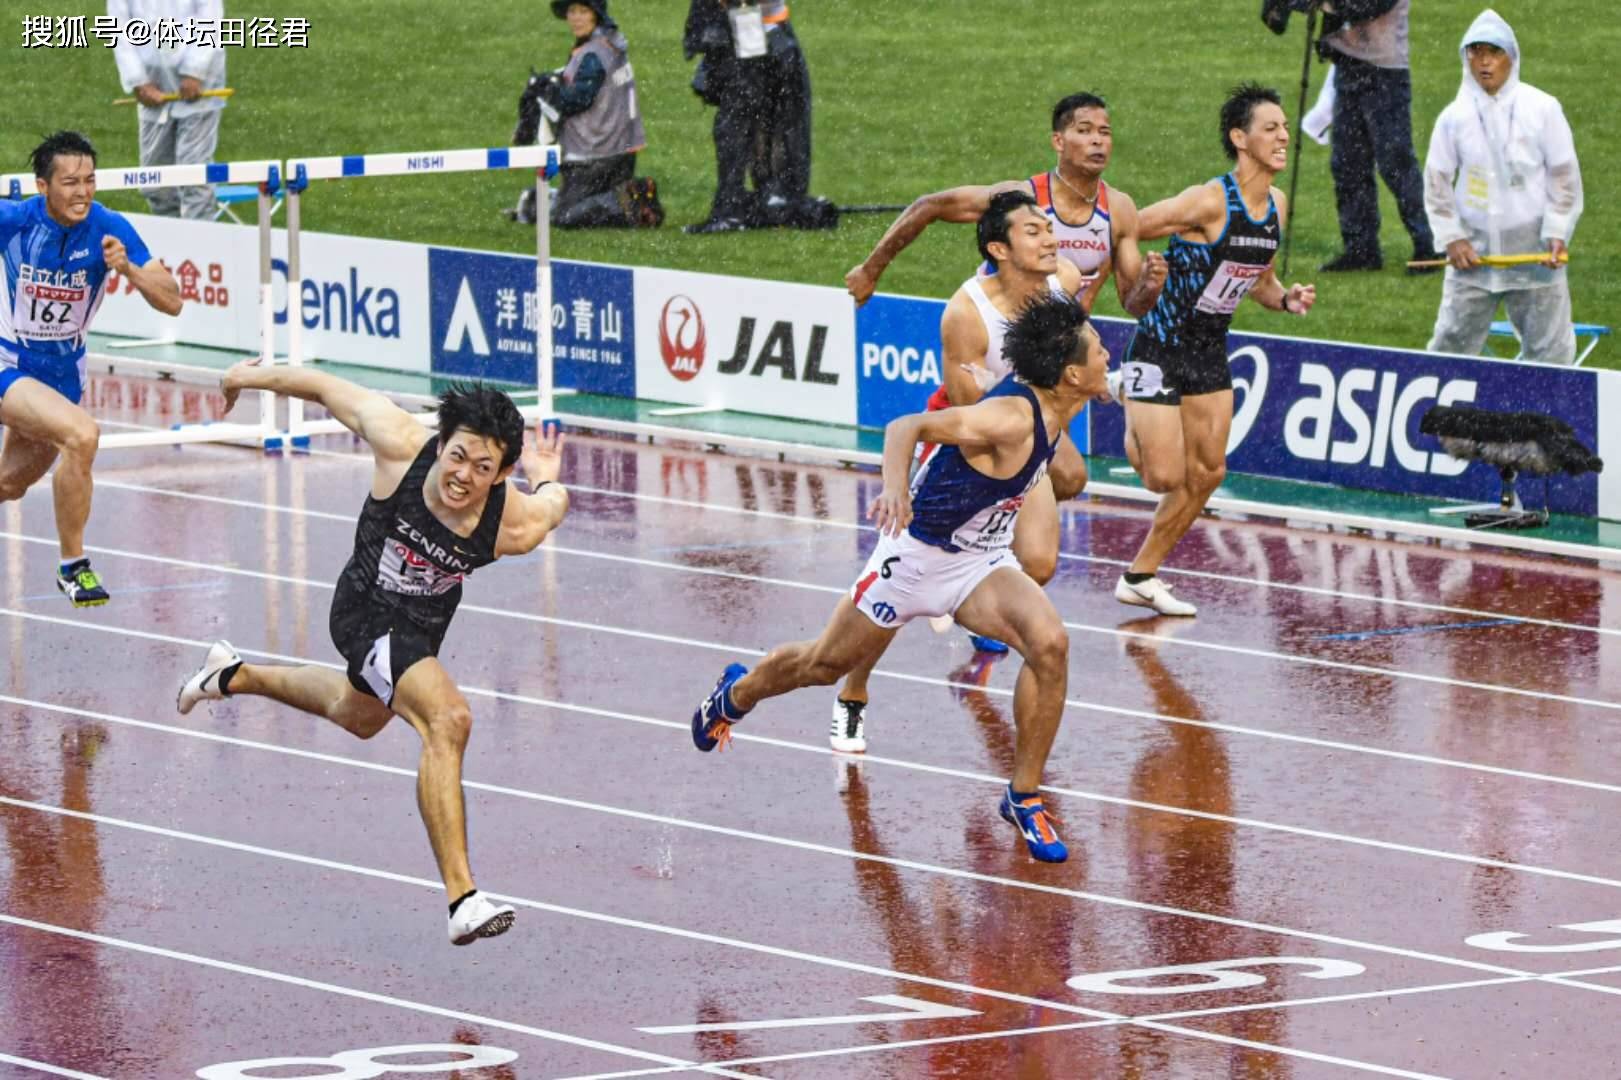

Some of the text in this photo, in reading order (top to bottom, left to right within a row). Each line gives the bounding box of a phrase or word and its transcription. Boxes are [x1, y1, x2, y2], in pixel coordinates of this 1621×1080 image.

[408, 155, 445, 171] NISHI
[123, 171, 162, 186] NISHI
[1058, 239, 1107, 252] RONA
[1218, 277, 1247, 299] 16
[30, 298, 73, 323] 162
[497, 338, 533, 355] AOYAMA
[570, 345, 598, 363] SINCE
[717, 315, 840, 386] JAL
[671, 355, 699, 374] JAL
[1131, 366, 1145, 393] 2
[1283, 362, 1477, 477] asics
[395, 517, 470, 571] ZENRIN
[881, 556, 901, 580] 6
